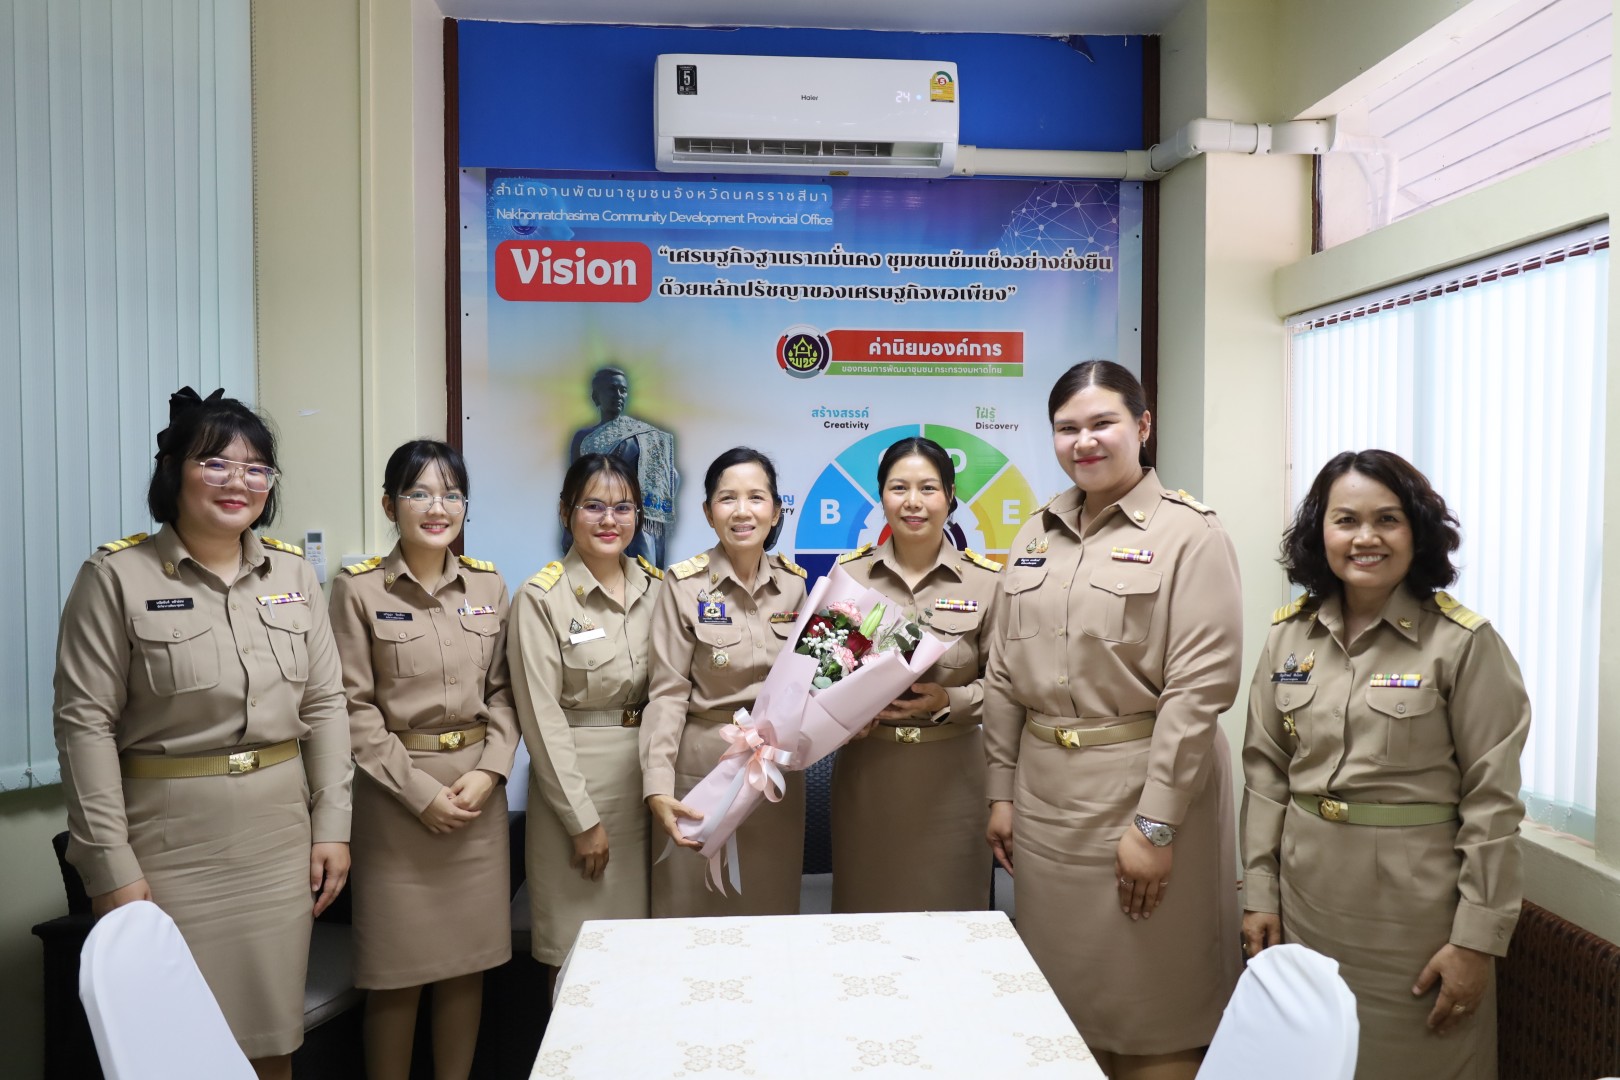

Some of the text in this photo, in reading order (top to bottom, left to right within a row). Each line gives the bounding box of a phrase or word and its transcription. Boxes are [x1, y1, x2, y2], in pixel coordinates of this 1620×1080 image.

[683, 70, 691, 86] 5
[896, 90, 910, 103] 24
[496, 183, 828, 202] สำนักงานพัฒนาชุมชนจังหวัดนครราชสีมา
[496, 208, 833, 226] Nakhonratchasima Community Development Provincial Office
[510, 247, 637, 286] Vision
[887, 247, 1113, 272] ชุมชนเข้มแข็งอย่างยั่งยืน
[868, 337, 1003, 357] ค่านิยมองค์การ
[811, 406, 869, 418] สร้างสรรค์
[975, 406, 997, 423] ใฝ่รู้
[823, 420, 869, 430] Creativity
[975, 421, 1019, 431] Discovery
[820, 498, 841, 525] B
[1002, 499, 1021, 525] E
